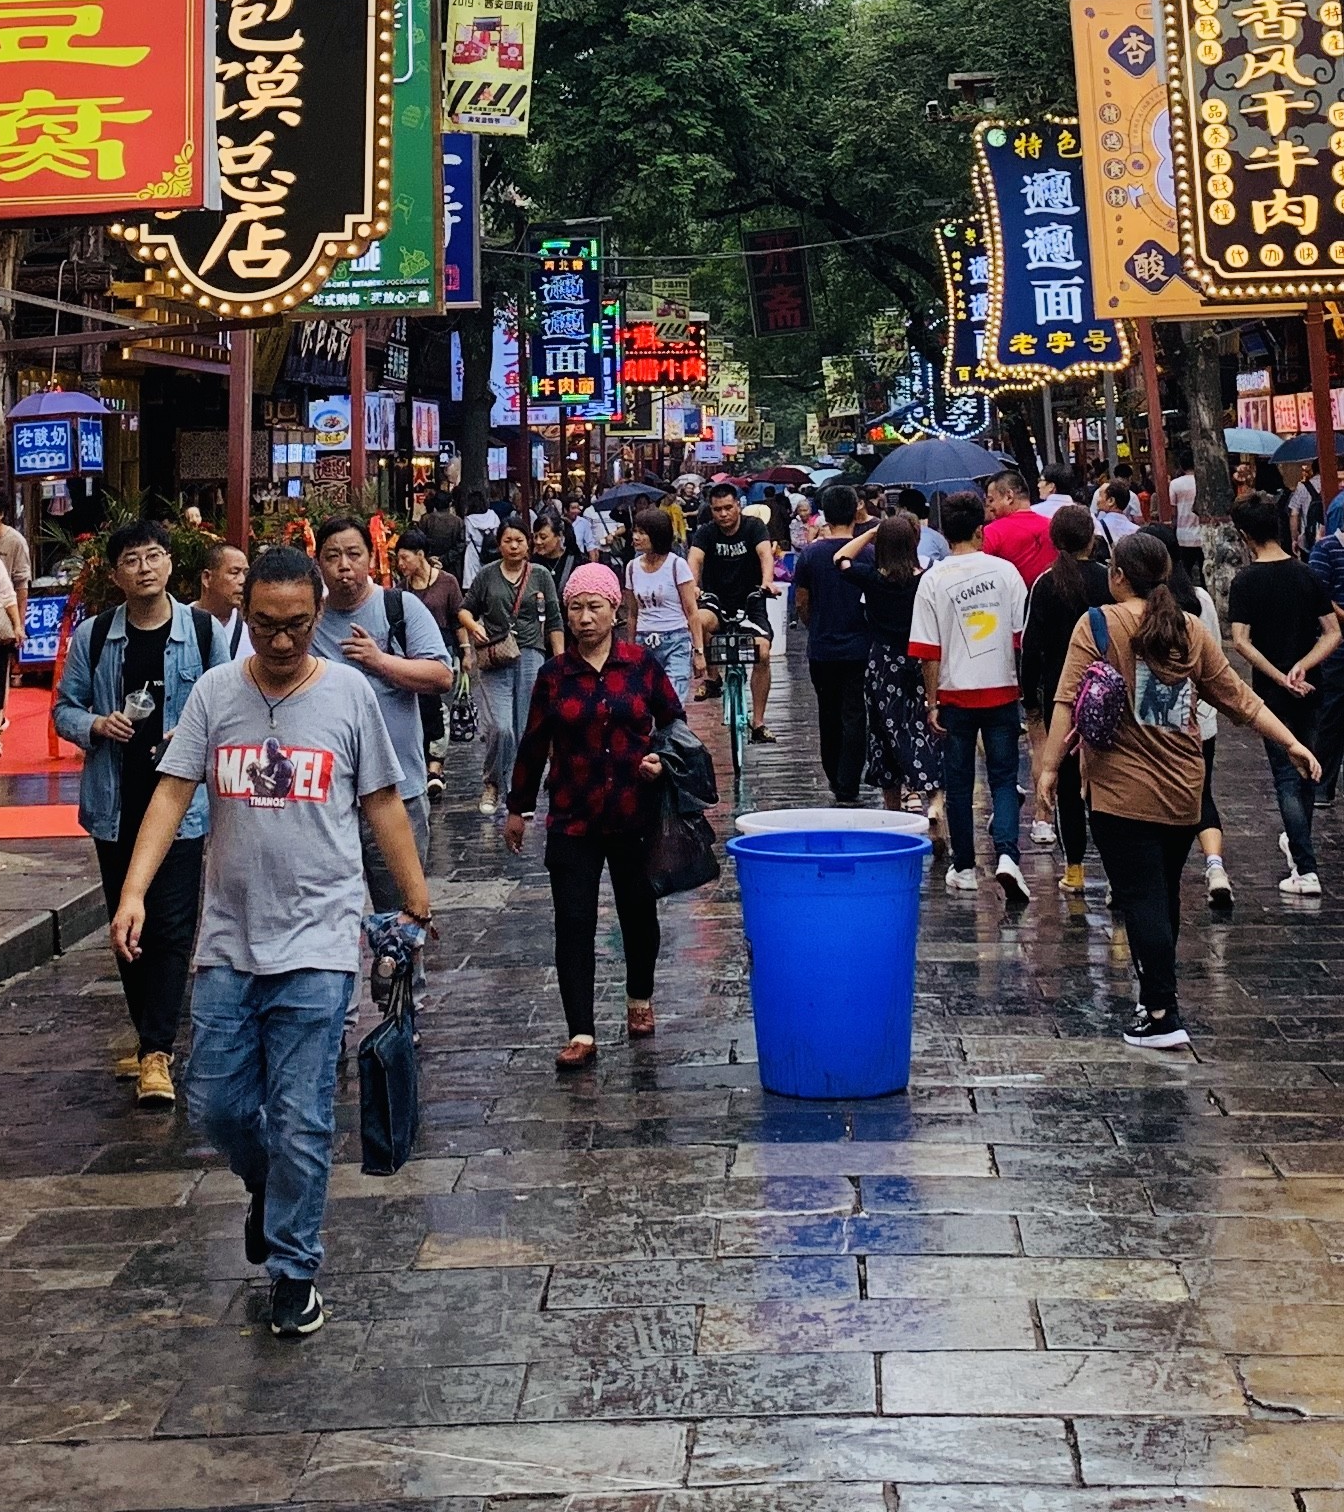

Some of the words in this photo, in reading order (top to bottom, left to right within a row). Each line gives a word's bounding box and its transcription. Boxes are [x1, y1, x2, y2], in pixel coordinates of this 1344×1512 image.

[484, 0, 534, 12] 西安回民街
[1013, 131, 1083, 160] 特色
[1132, 250, 1170, 284] 酸
[308, 289, 431, 307] 站式购物·买放心产品
[1008, 330, 1113, 355] 老字号
[539, 376, 595, 396] 牛肉面
[16, 424, 68, 449] 老酸奶
[217, 747, 325, 799] MAEL
[249, 796, 286, 808] THANOS
